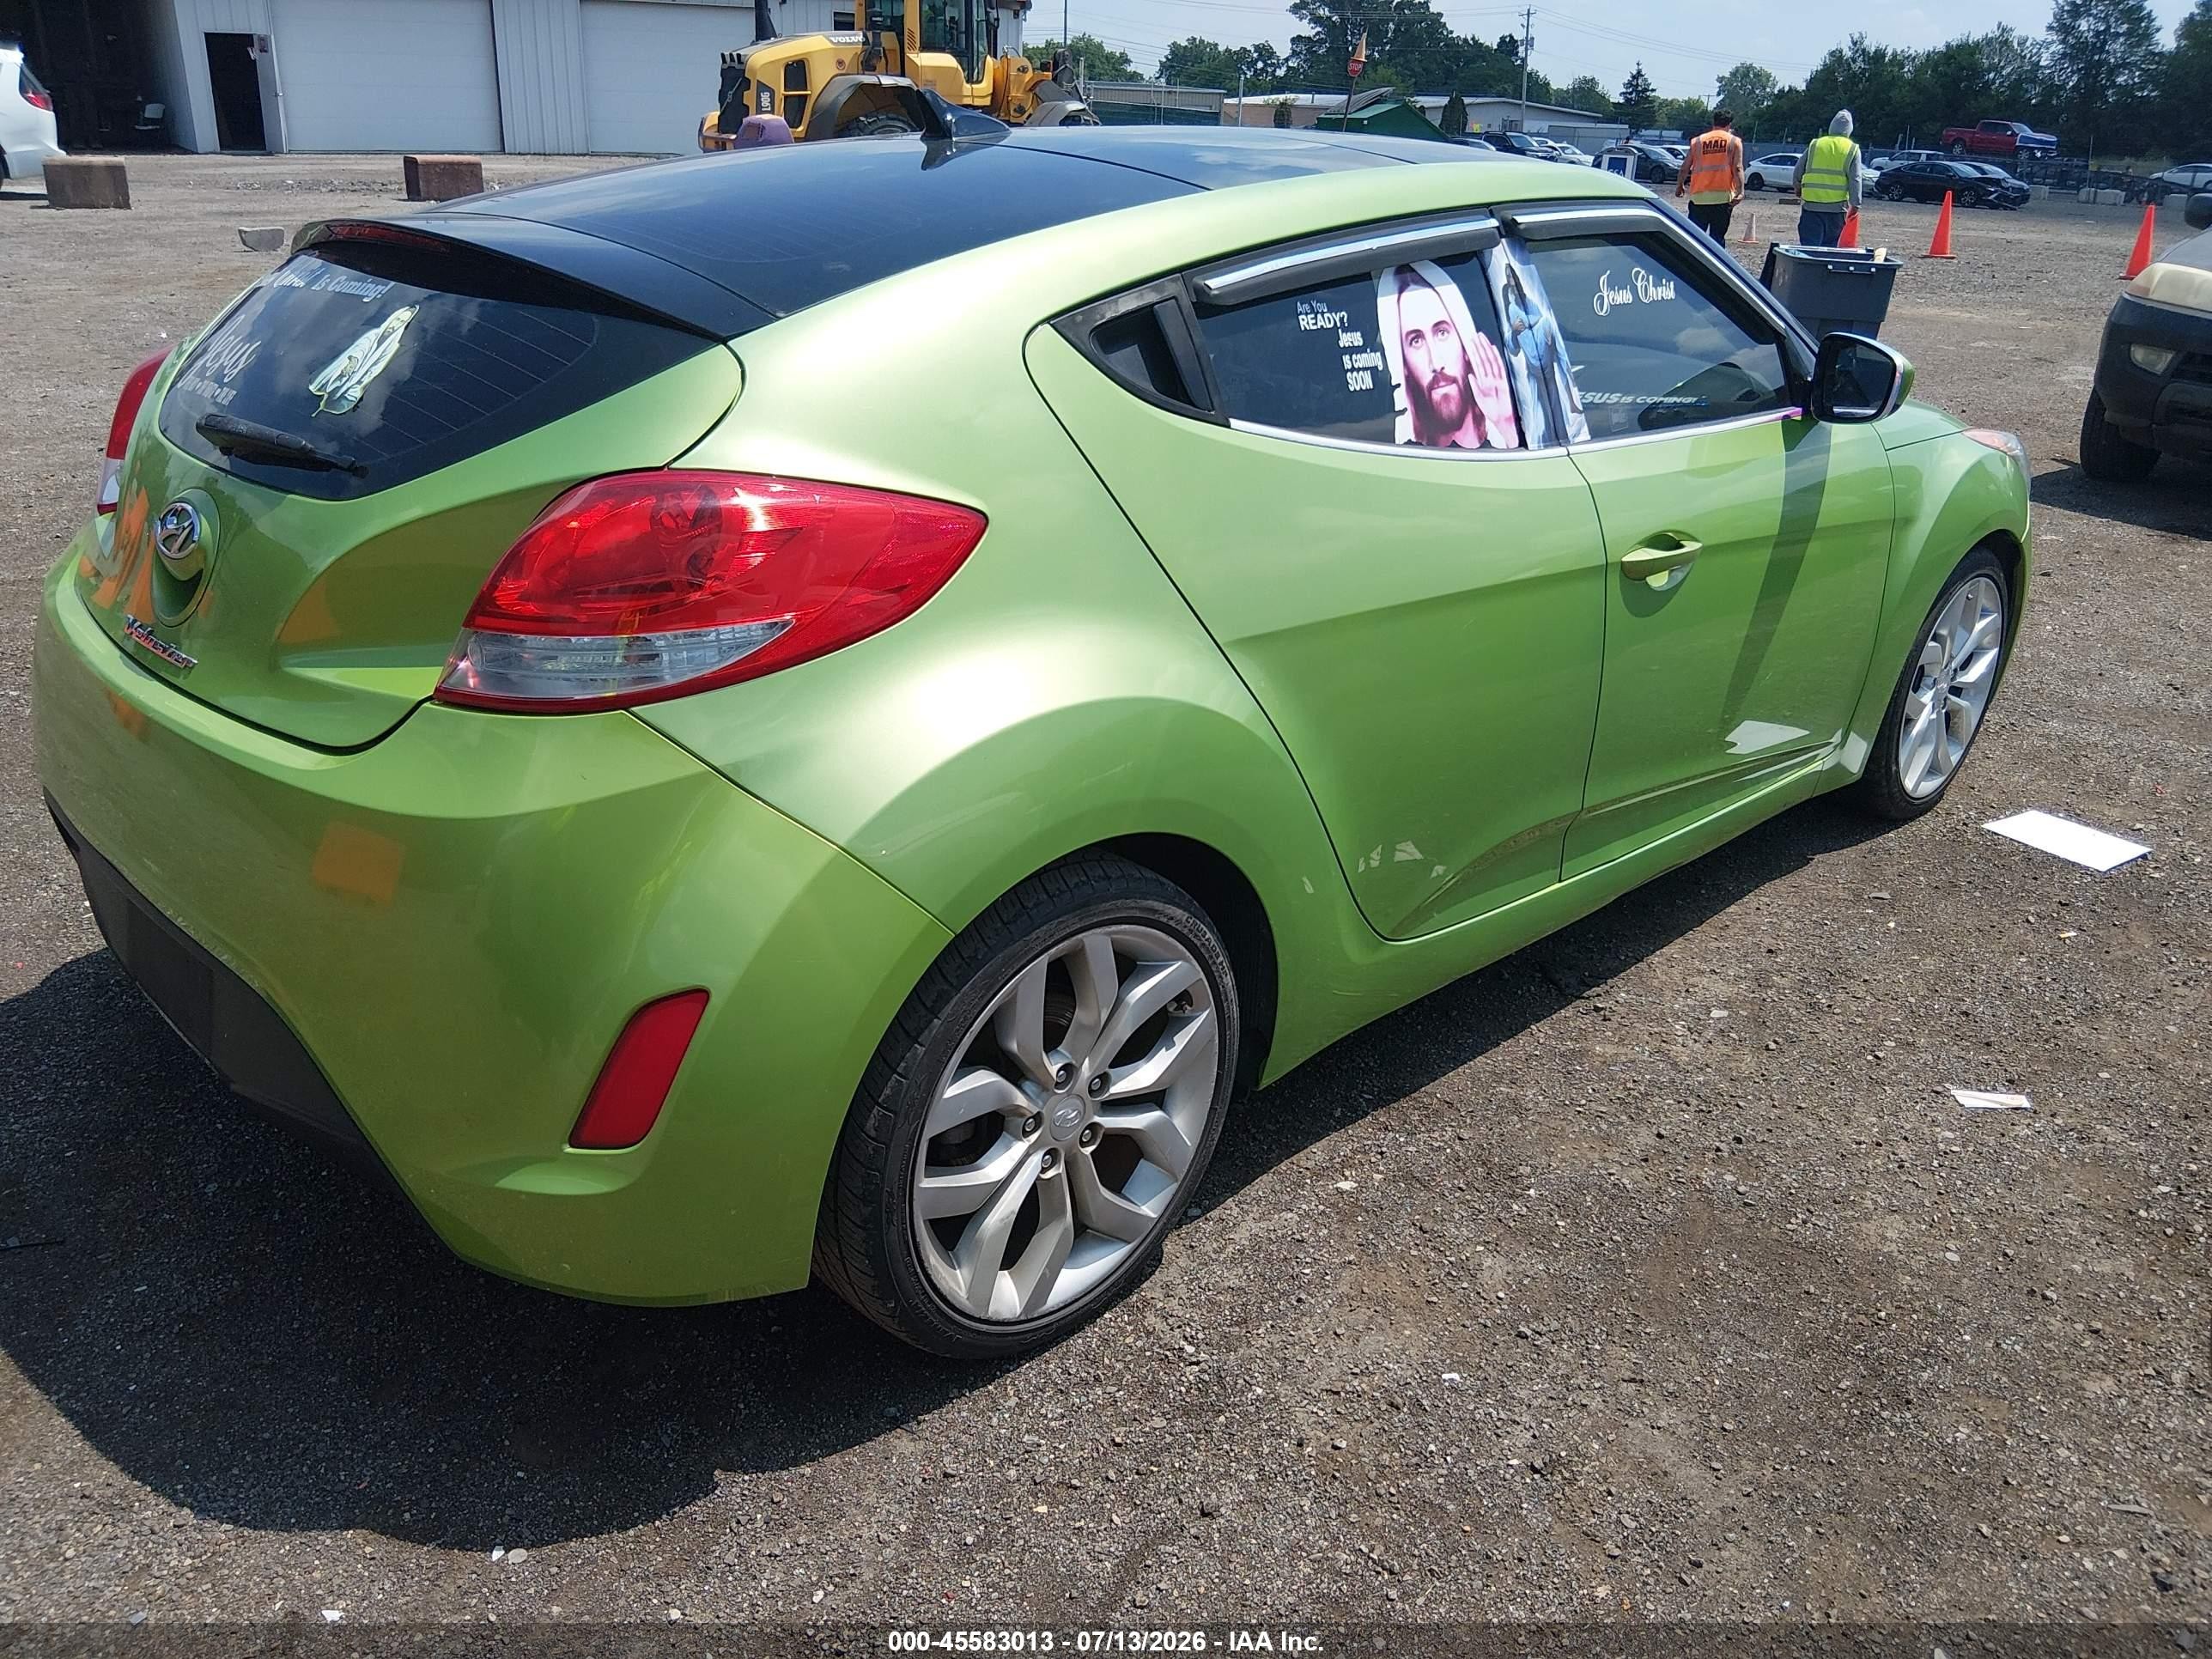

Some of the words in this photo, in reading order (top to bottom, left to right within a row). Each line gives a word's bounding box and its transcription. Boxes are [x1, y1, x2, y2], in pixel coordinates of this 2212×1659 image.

[761, 91, 771, 111] L90G
[1703, 139, 1727, 150] MAD
[327, 276, 396, 302] Coming!
[1593, 270, 1632, 316] Jesus
[1632, 267, 1675, 303] Christ
[1297, 301, 1310, 314] Are
[1310, 300, 1328, 313] You
[1298, 312, 1348, 331] READY?
[1338, 328, 1364, 348] Jesus
[177, 314, 262, 389] Jesus
[1352, 348, 1383, 370] coming
[1346, 370, 1374, 392] SOON
[1578, 392, 1621, 404] ESUS
